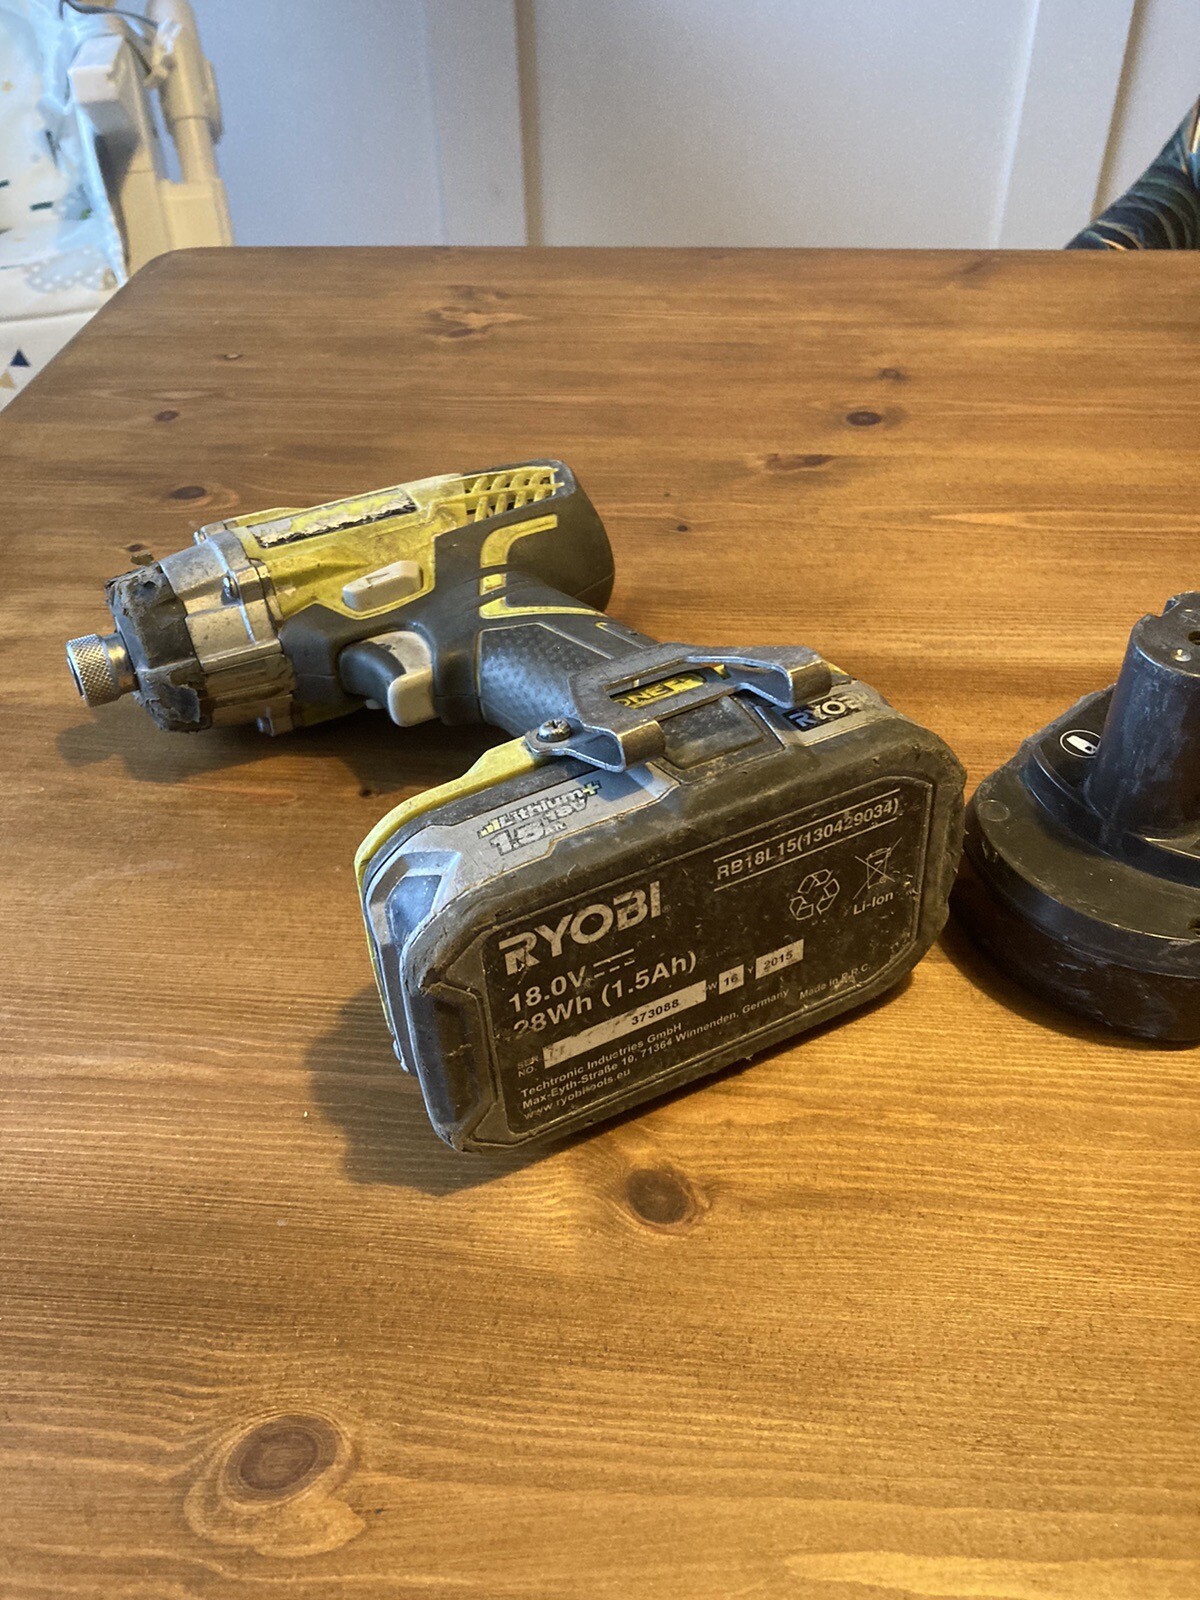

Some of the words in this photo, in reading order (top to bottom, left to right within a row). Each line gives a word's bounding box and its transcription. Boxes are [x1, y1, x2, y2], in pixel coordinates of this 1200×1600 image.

[788, 691, 866, 727] RYOB
[498, 880, 662, 976] RYOBI
[853, 891, 894, 916] Li-Ion
[508, 966, 587, 1013] 18.0V
[513, 995, 593, 1040] 28Wh
[601, 951, 697, 1007] (1.5Ah)
[630, 998, 680, 1025] 373088
[723, 973, 739, 987] 16
[763, 950, 794, 971] 2015
[520, 1066, 584, 1098] Techtronic
[587, 1040, 644, 1070] Industries
[646, 1022, 682, 1044] GmbH
[522, 1062, 619, 1109] Max-Eyth-Straße
[640, 1039, 673, 1058] 71364
[675, 1012, 740, 1042] Winnenden,
[741, 988, 789, 1014] Germany
[799, 983, 827, 1000] Made
[829, 978, 839, 987] in
